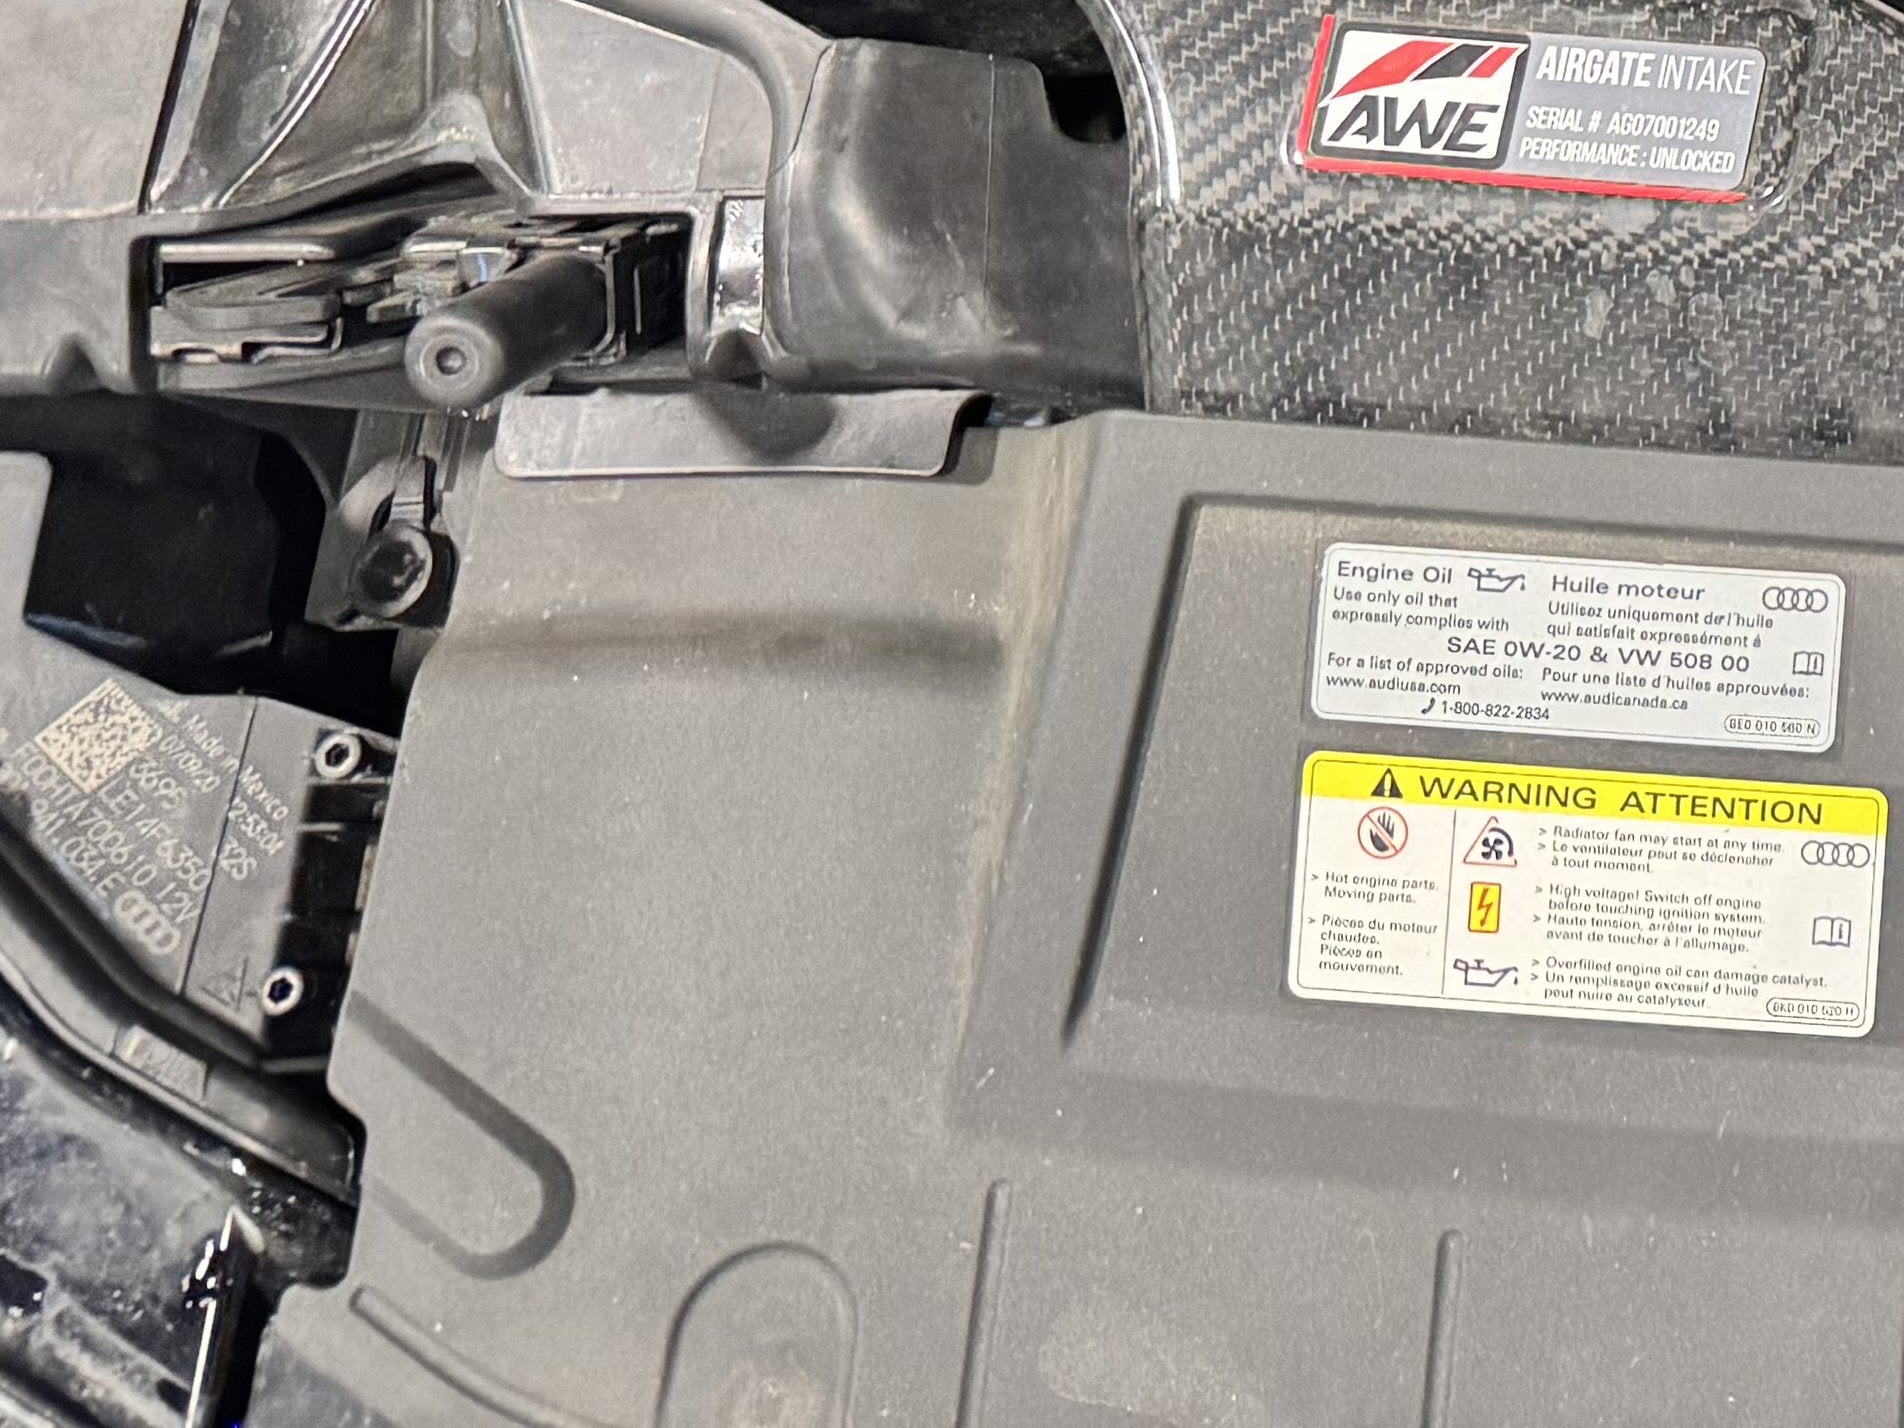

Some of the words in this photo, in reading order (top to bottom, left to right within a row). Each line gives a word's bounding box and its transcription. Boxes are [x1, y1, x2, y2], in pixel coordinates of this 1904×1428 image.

[1536, 46, 1655, 88] AIRGATE
[1657, 53, 1756, 95] INTAKE
[1327, 95, 1500, 153] AWE
[1525, 106, 1586, 132] SERIAL
[1588, 111, 1602, 132] #
[1608, 110, 1721, 141] AG07001249
[1519, 138, 1638, 165] PERFORMANCE
[1649, 147, 1736, 174] UNLOCKED
[1337, 561, 1414, 582] Engine
[1423, 566, 1453, 584] Oil
[1334, 587, 1362, 601] Use
[1367, 590, 1401, 606] only
[1404, 591, 1423, 605] oil
[1429, 594, 1458, 608] that
[1552, 575, 1609, 595] Huile
[1618, 584, 1706, 600] moteur
[1332, 609, 1401, 626] expressly
[1406, 614, 1473, 630] complies
[1478, 616, 1509, 631] with
[1548, 600, 1602, 618] Utilisez
[1608, 606, 1699, 624] uniquement
[1547, 623, 1571, 638] qui
[1576, 624, 1636, 640] satisfait
[1327, 652, 1351, 667] For
[1356, 658, 1365, 668] a
[1370, 655, 1391, 671] list
[1397, 658, 1413, 672] of
[1416, 662, 1487, 677] approved
[1447, 636, 1496, 656] SAE
[1504, 640, 1581, 662] 0W-20
[1590, 646, 1608, 663] &
[1618, 646, 1662, 667] VW
[1670, 651, 1712, 670] 508
[1721, 654, 1750, 672] 00
[1326, 675, 1461, 694] www.audiusa.com
[1542, 668, 1578, 684] Pour
[1583, 672, 1610, 685] une
[1616, 670, 1646, 688] liste
[1441, 700, 1550, 720] 1-800-822-2834
[1541, 690, 1688, 710] www.audicanada.ca
[238, 765, 288, 819] Mexico
[1418, 776, 1598, 809] WARNING
[1619, 792, 1823, 825] ATTENTION
[1553, 825, 1610, 841] Radiator
[1615, 828, 1636, 843] fan
[1639, 832, 1669, 847] may
[1672, 835, 1703, 848] start
[1724, 840, 1746, 853] any
[1325, 871, 1348, 884] Hot
[1353, 876, 1398, 888] engine
[1324, 886, 1375, 903] Moving
[1550, 883, 1581, 900] High
[1645, 889, 1689, 904] Switch
[1694, 893, 1713, 906] off
[1595, 902, 1656, 919] touching
[1659, 907, 1710, 922] ignition
[1369, 919, 1385, 930] du
[1546, 956, 1612, 972] Overfilled
